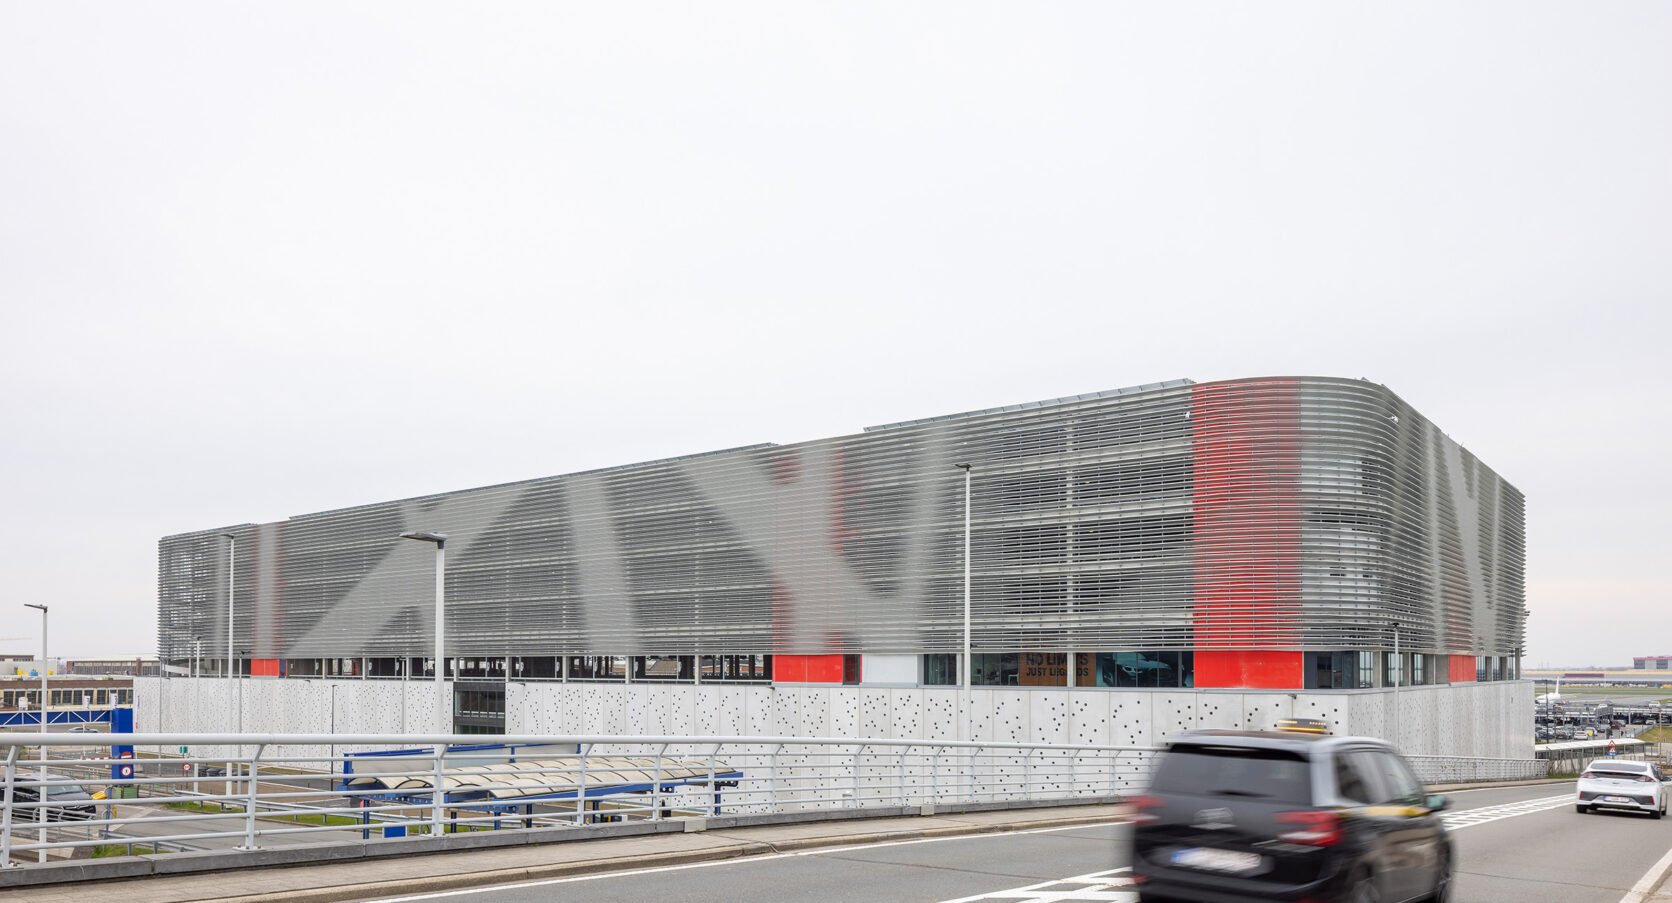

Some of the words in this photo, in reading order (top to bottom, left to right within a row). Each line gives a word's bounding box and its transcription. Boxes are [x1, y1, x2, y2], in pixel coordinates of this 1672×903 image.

[1026, 653, 1043, 665] NO
[1047, 653, 1088, 665] LIMS
[1026, 667, 1047, 676] JUST
[1049, 667, 1088, 676] LEGDS
